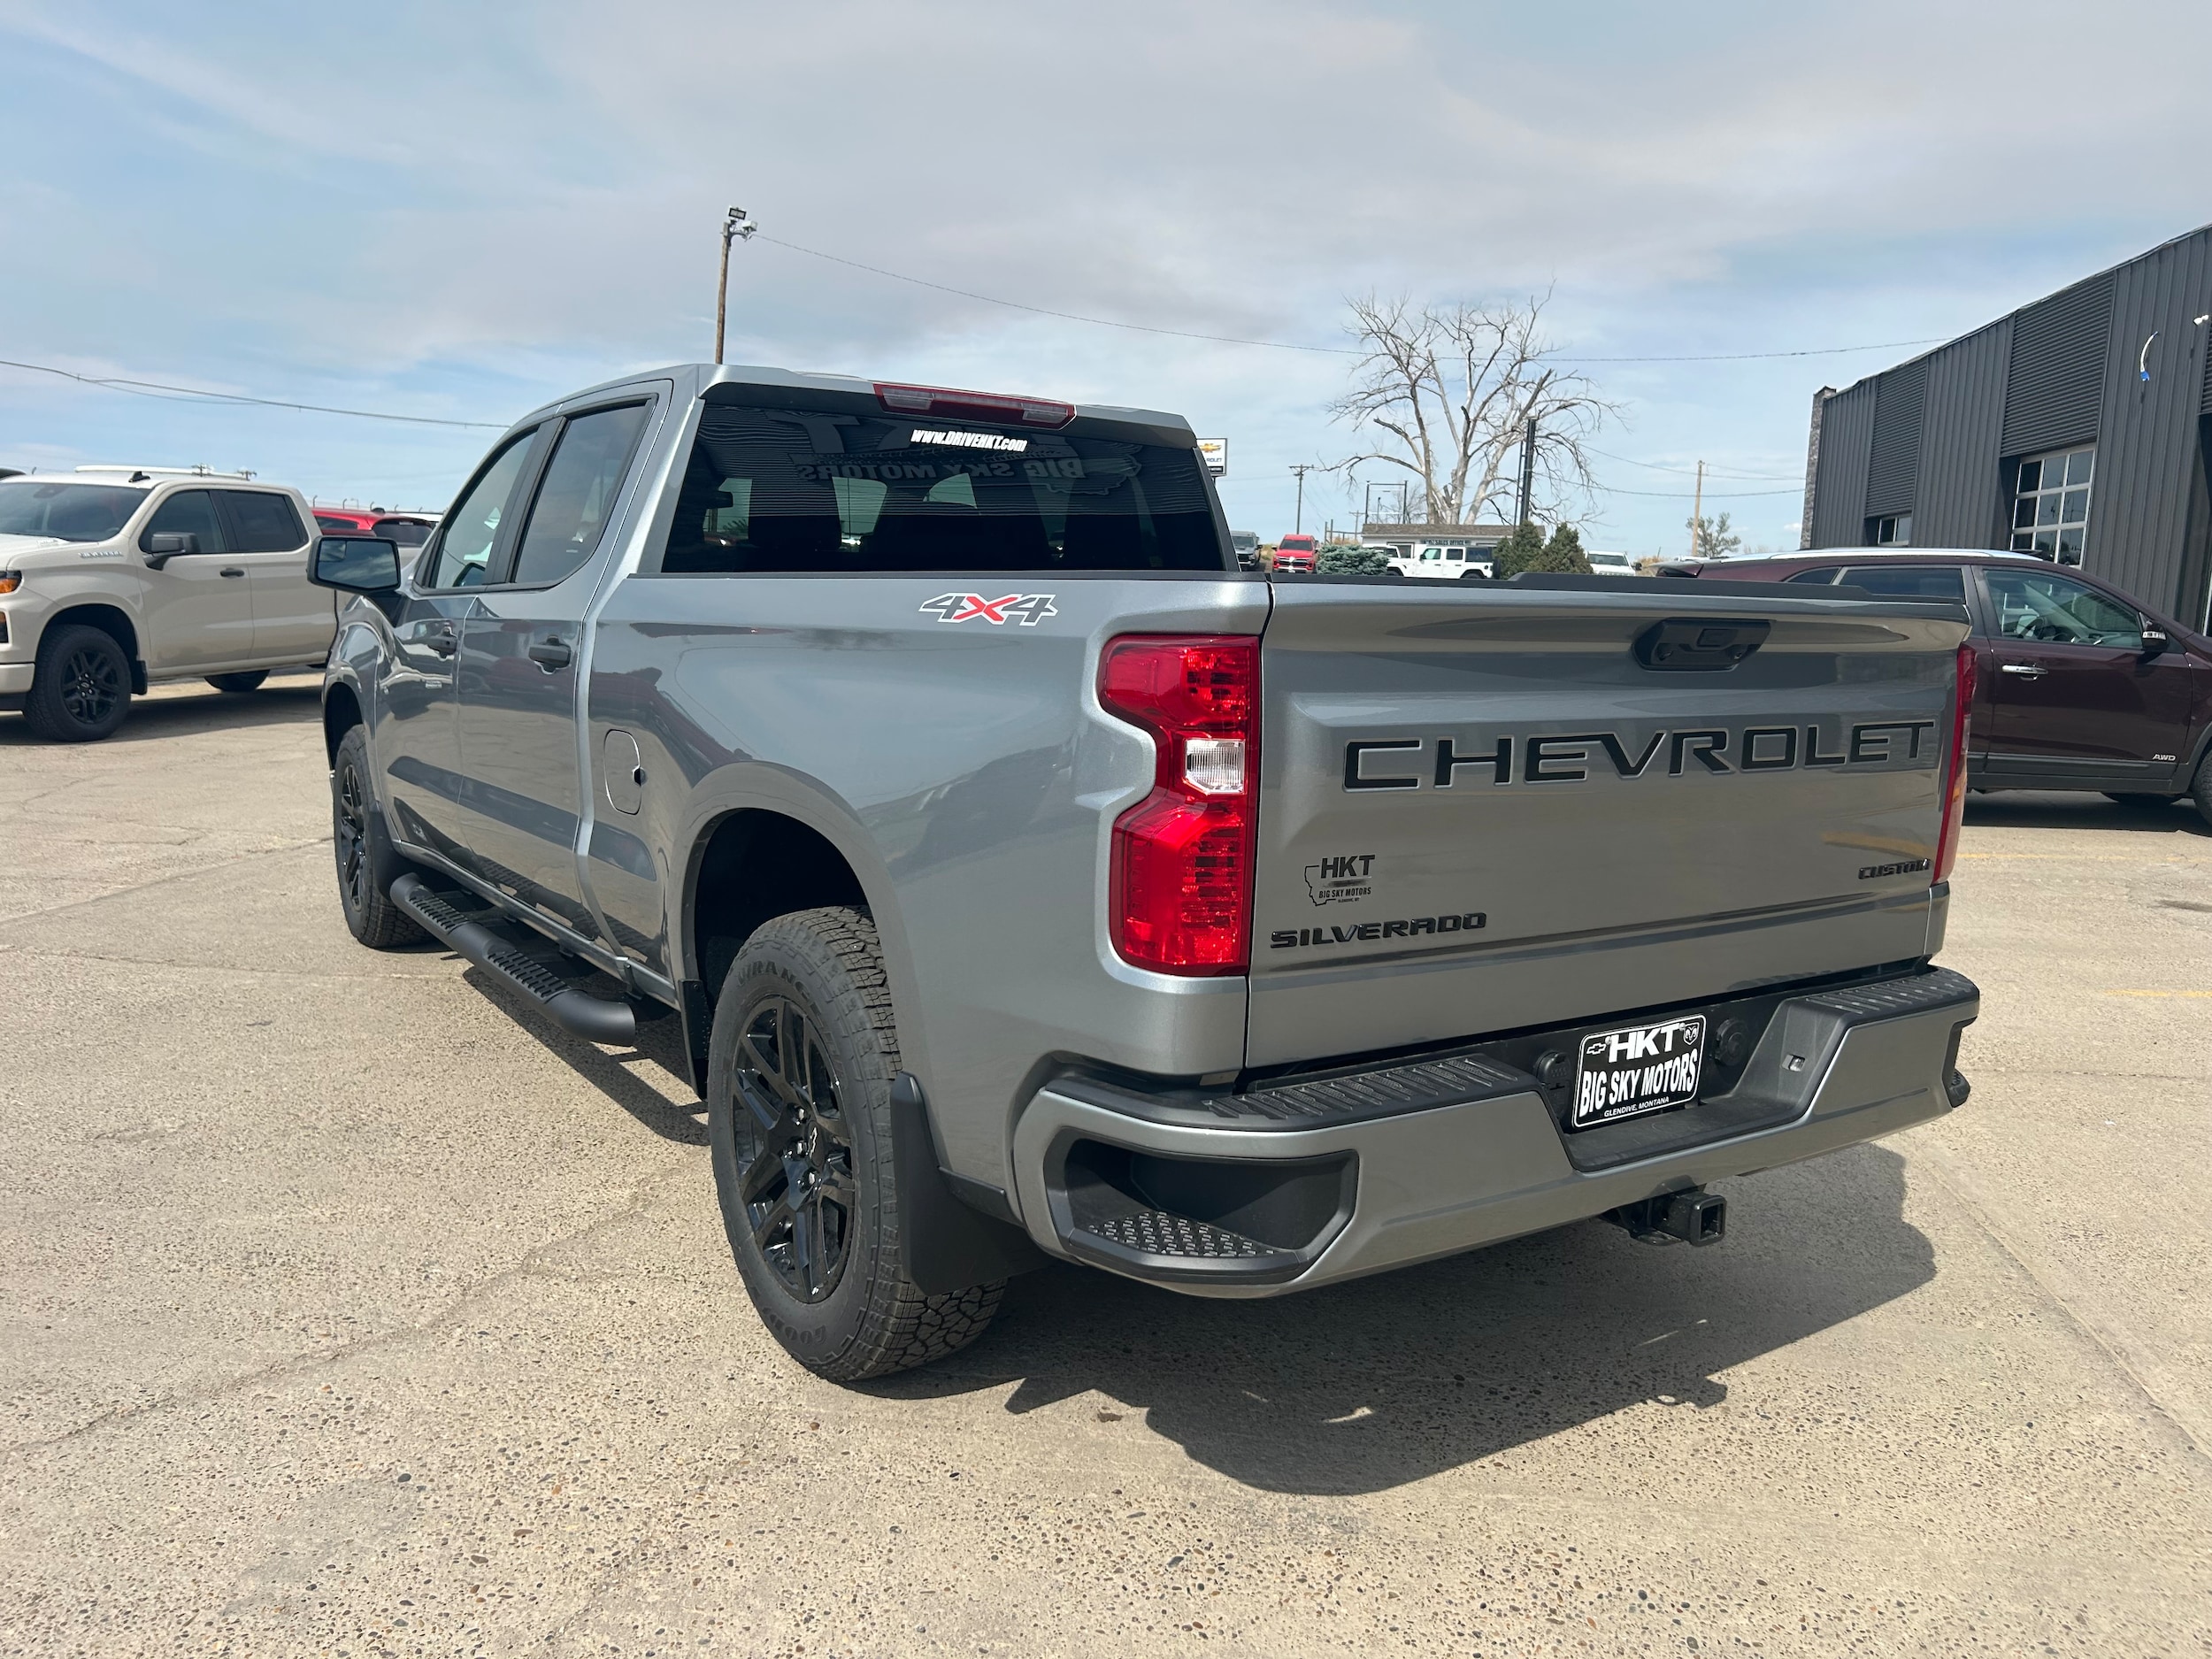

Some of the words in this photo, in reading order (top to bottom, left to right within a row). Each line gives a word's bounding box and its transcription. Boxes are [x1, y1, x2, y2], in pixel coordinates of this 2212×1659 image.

[1342, 718, 1937, 793] CHEVROLET
[2152, 753, 2177, 762] AWD
[1320, 854, 1376, 879] HKT
[1858, 858, 1931, 879] CUSTOM
[1318, 890, 1331, 899] BIG
[1332, 888, 1344, 898] SKY
[1345, 887, 1371, 896] MOTORS
[1270, 912, 1487, 949] SILVERADO
[1609, 1022, 1681, 1063] HKT
[1578, 1070, 1607, 1118] BIG
[1609, 1068, 1641, 1105] SKY
[1640, 1048, 1698, 1096] MOTORS
[1638, 1096, 1670, 1109] MONTANA
